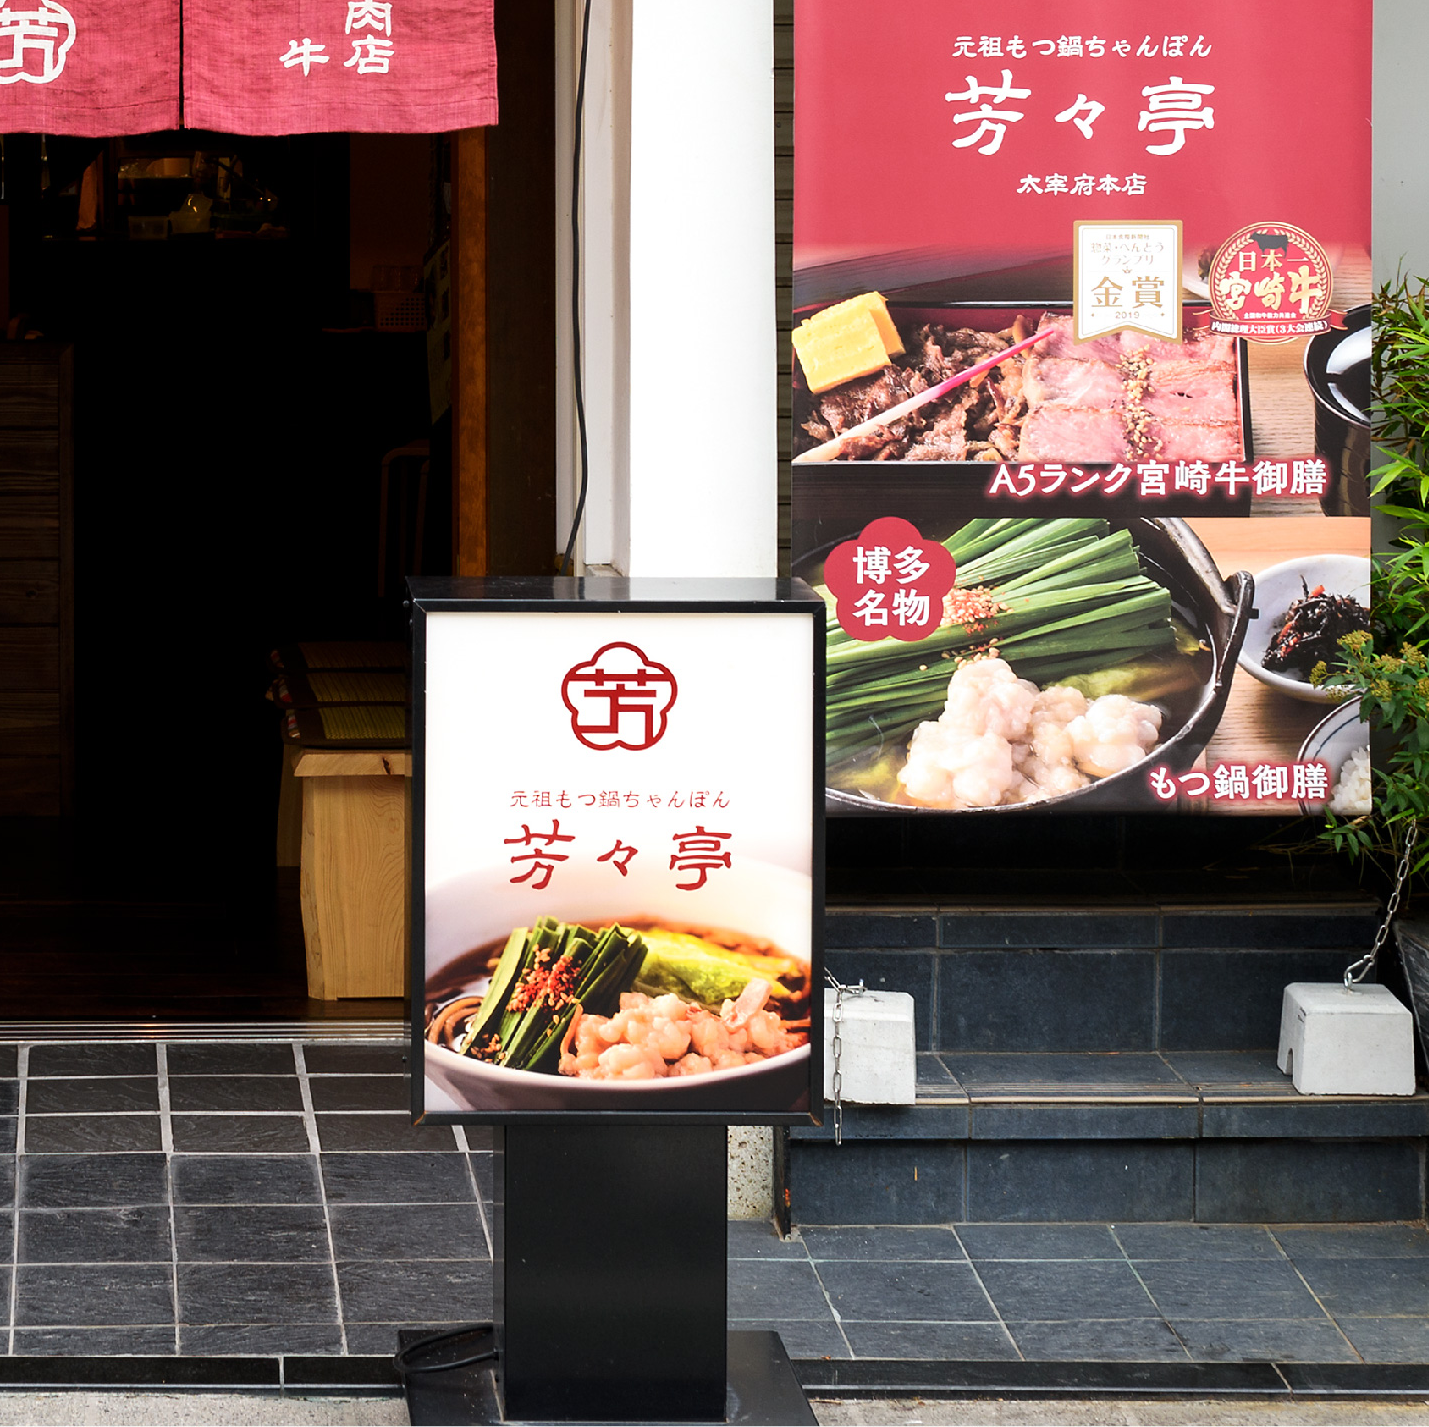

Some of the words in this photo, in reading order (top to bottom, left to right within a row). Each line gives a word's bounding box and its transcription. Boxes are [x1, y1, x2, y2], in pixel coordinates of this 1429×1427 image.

[952, 35, 1212, 59] 元祖もつ鍋ちゃんぽん
[944, 69, 1215, 156] 芳々亭
[1016, 173, 1147, 196] 太宰府本店
[1238, 250, 1310, 272] 日本一
[1091, 276, 1165, 309] 金賞
[1220, 265, 1323, 314] 宮崎牛
[1115, 311, 1140, 320] 2019
[989, 459, 1327, 497] A5ランク宮崎牛御膳
[852, 546, 930, 585] 博多
[852, 588, 930, 626] 名物
[510, 789, 730, 809] 元祖もつ鍋ちゃんぽん
[1149, 764, 1328, 799] もつ鍋御膳
[504, 819, 733, 891] 芳々亭
